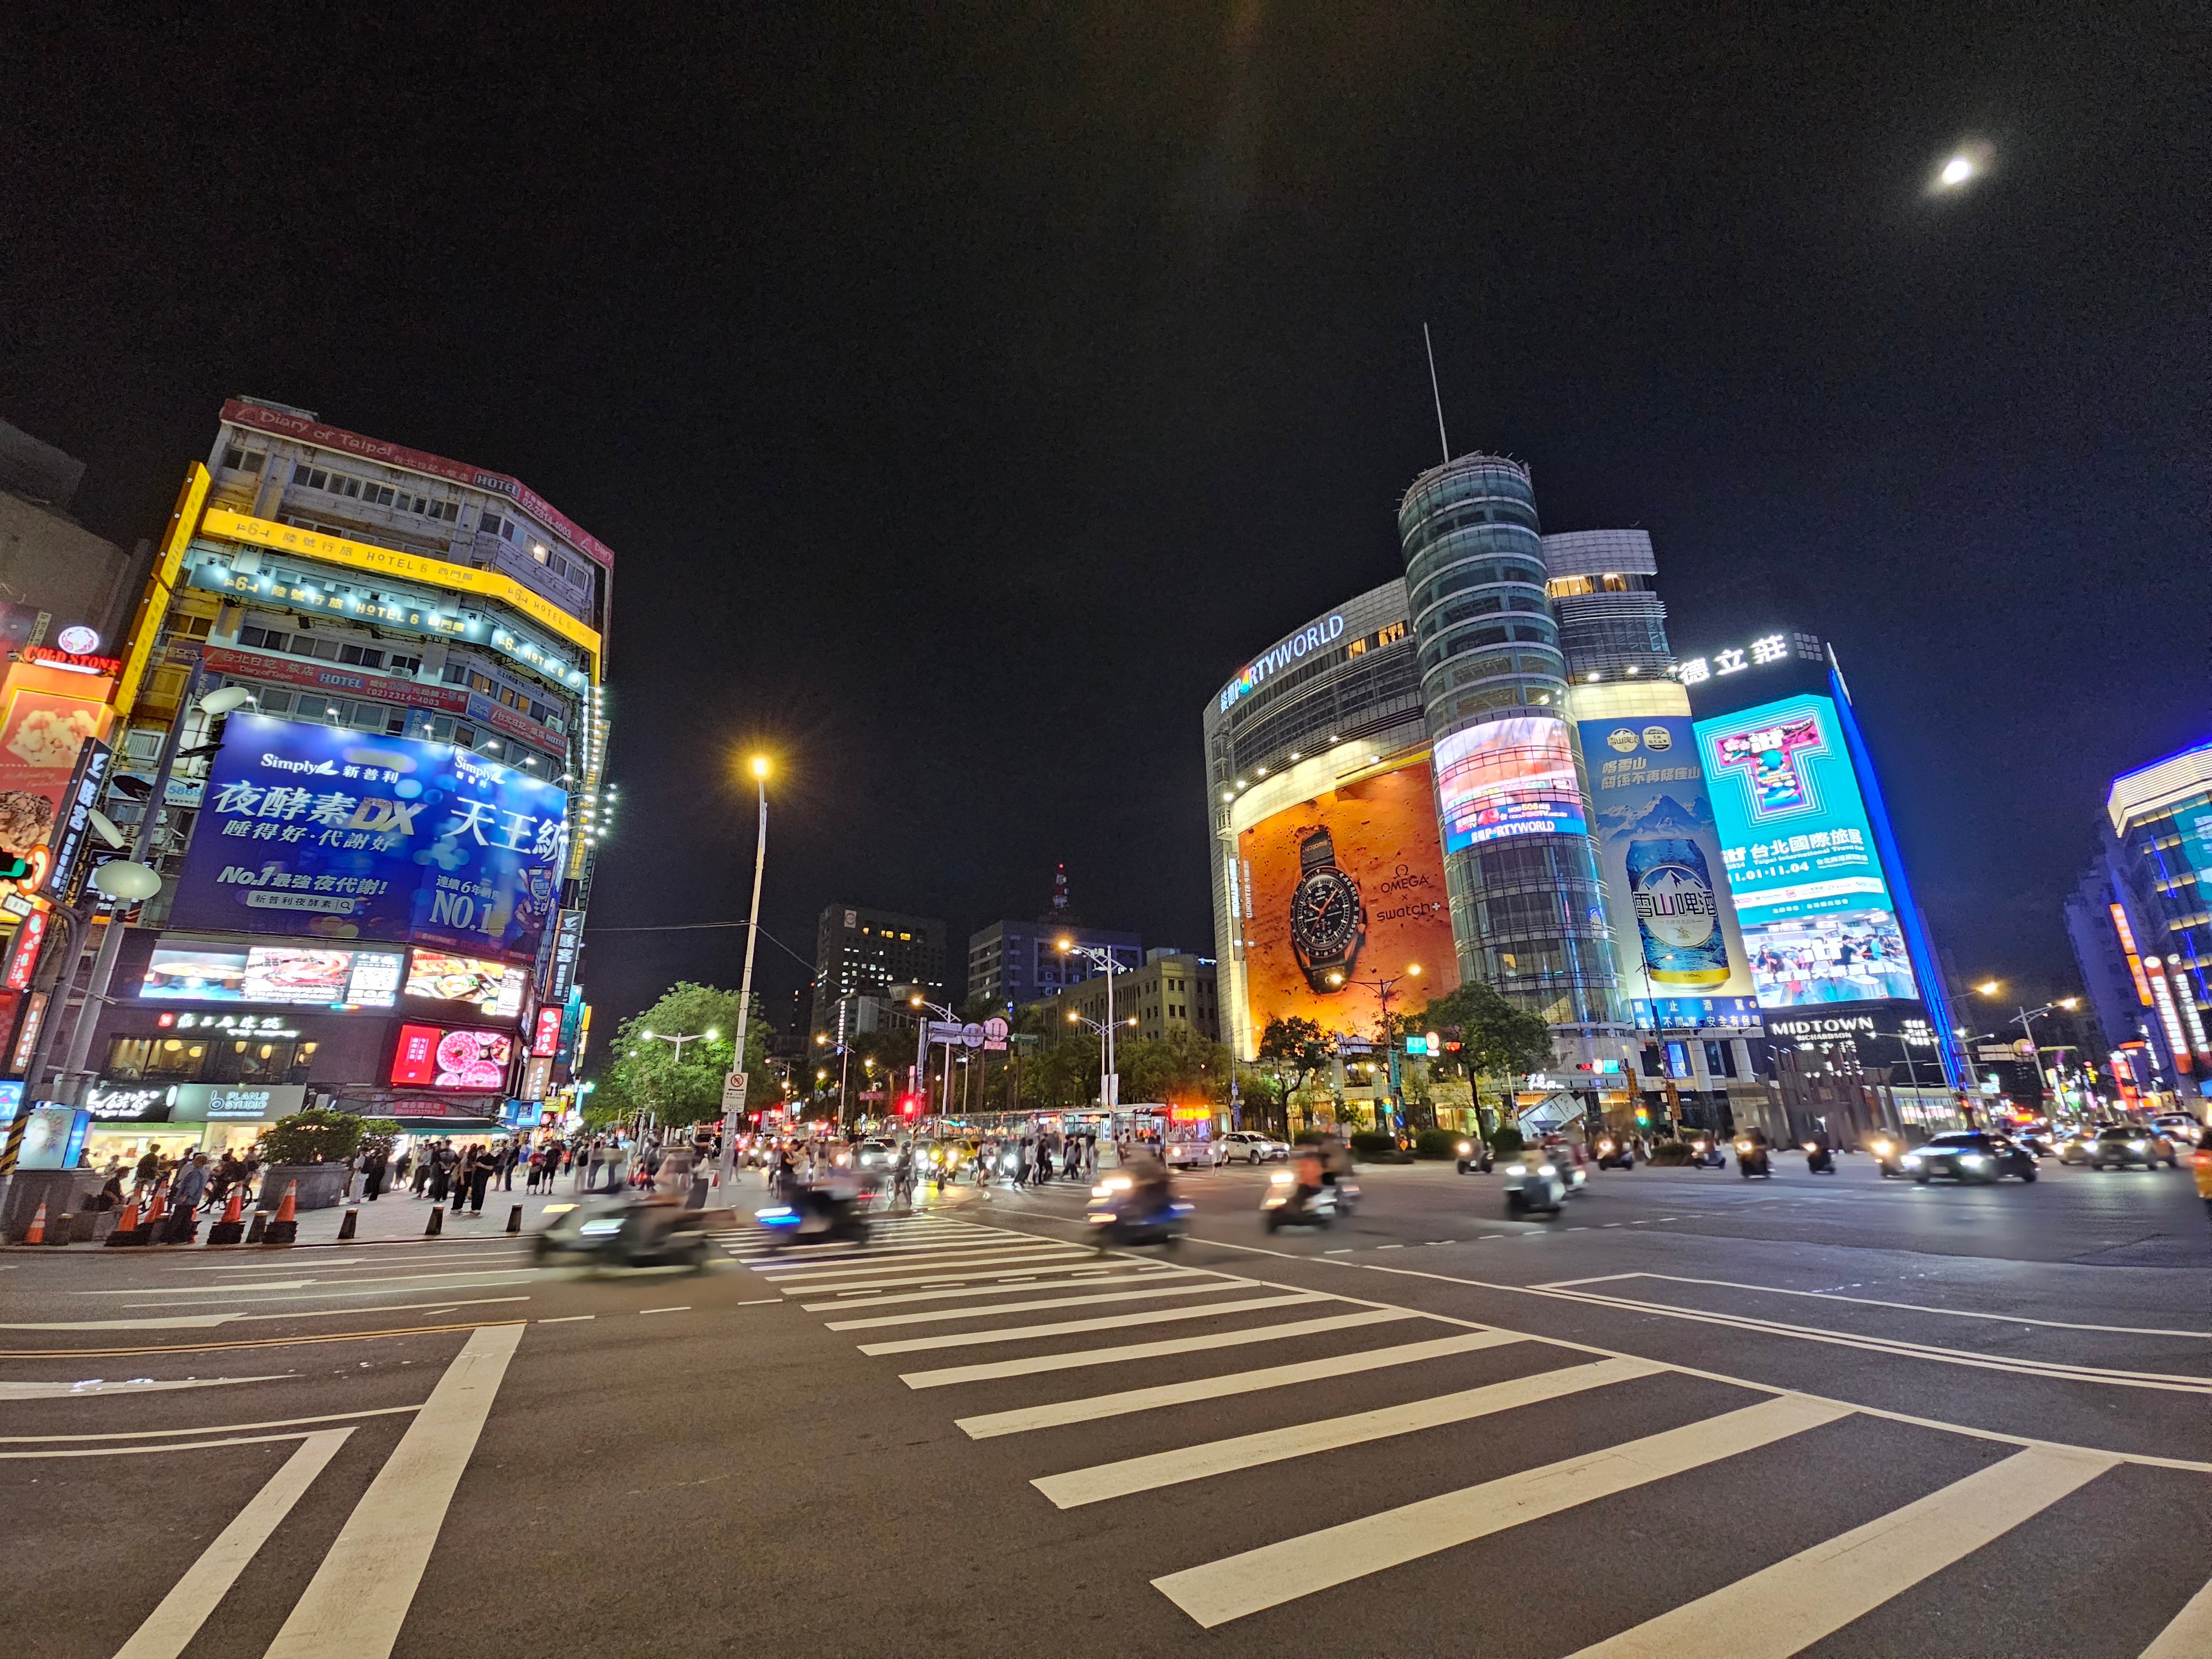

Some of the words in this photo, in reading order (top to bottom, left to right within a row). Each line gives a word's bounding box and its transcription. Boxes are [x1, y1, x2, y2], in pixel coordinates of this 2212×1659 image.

[259, 411, 310, 433] Diary
[314, 428, 334, 441] of
[340, 433, 392, 456] Taipei
[476, 474, 518, 495] HOTEL
[367, 551, 412, 570] HOTEL
[420, 564, 429, 573] 6
[356, 602, 405, 623] HOTEL
[410, 613, 419, 625] 6
[534, 601, 564, 626] HOTEL
[24, 646, 67, 662] COLD
[69, 654, 121, 670] STONE
[524, 649, 555, 674] HOTEL
[1679, 634, 1788, 686] 德立莊
[319, 673, 362, 688] HOTEL
[367, 687, 440, 706] (02)2314-4003
[260, 753, 319, 775] Simply
[342, 765, 399, 784] 新普利
[454, 755, 493, 781] Simply
[1602, 757, 1647, 774] 喝雪山
[1601, 766, 1700, 790] 關係不再隔座山
[1750, 828, 1864, 859] 台北國際旅展
[1753, 857, 1777, 865] Taipei
[1380, 874, 1430, 893] OMEGA
[254, 894, 333, 909] 新普利夜酵素
[429, 889, 493, 934] NO.1
[1376, 902, 1431, 922] swatch
[1634, 891, 1717, 917] 雪山啤酒
[1771, 1016, 1875, 1036] MIDTOWN
[225, 1100, 267, 1109] STUDIO
